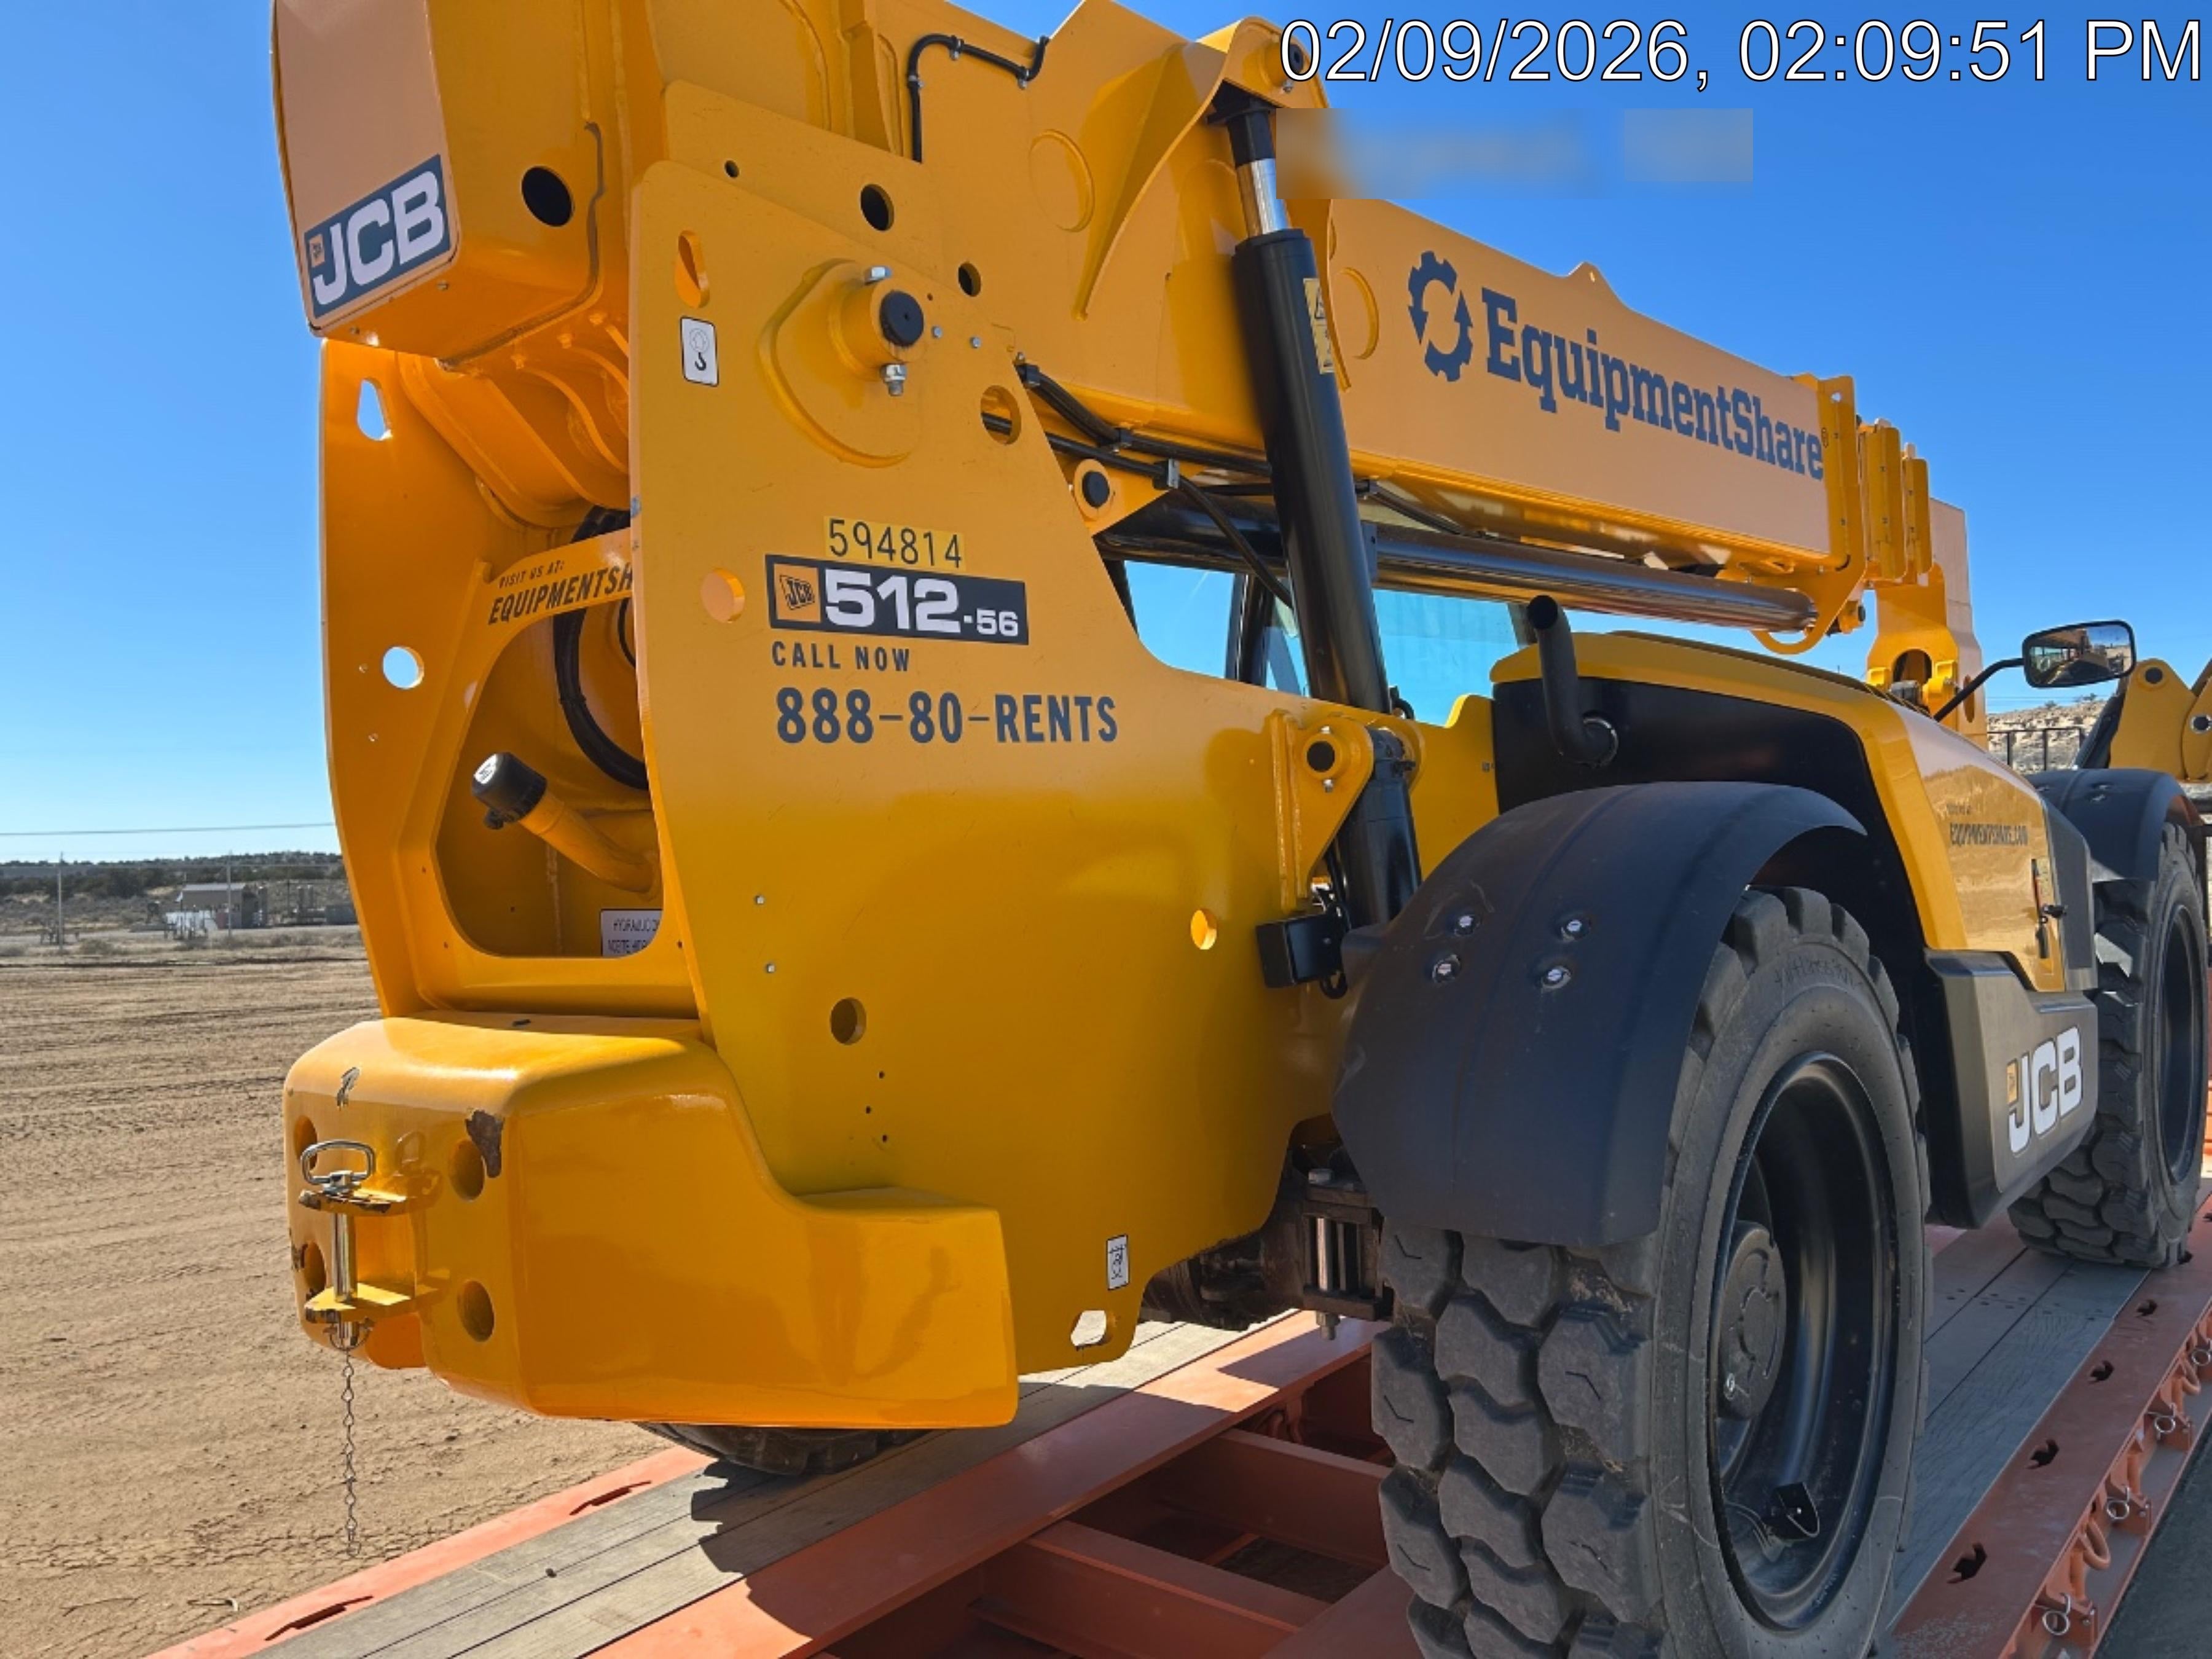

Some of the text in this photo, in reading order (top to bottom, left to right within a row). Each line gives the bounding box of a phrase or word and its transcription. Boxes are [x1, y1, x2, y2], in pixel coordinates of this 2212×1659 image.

[313, 170, 445, 305] JCB
[1481, 286, 1824, 480] EquipmentShare
[830, 518, 962, 568] 594814
[772, 641, 909, 671] CALL NOW
[776, 687, 1118, 743] 888-80-RENTS
[2008, 1026, 2083, 1153] JCB
